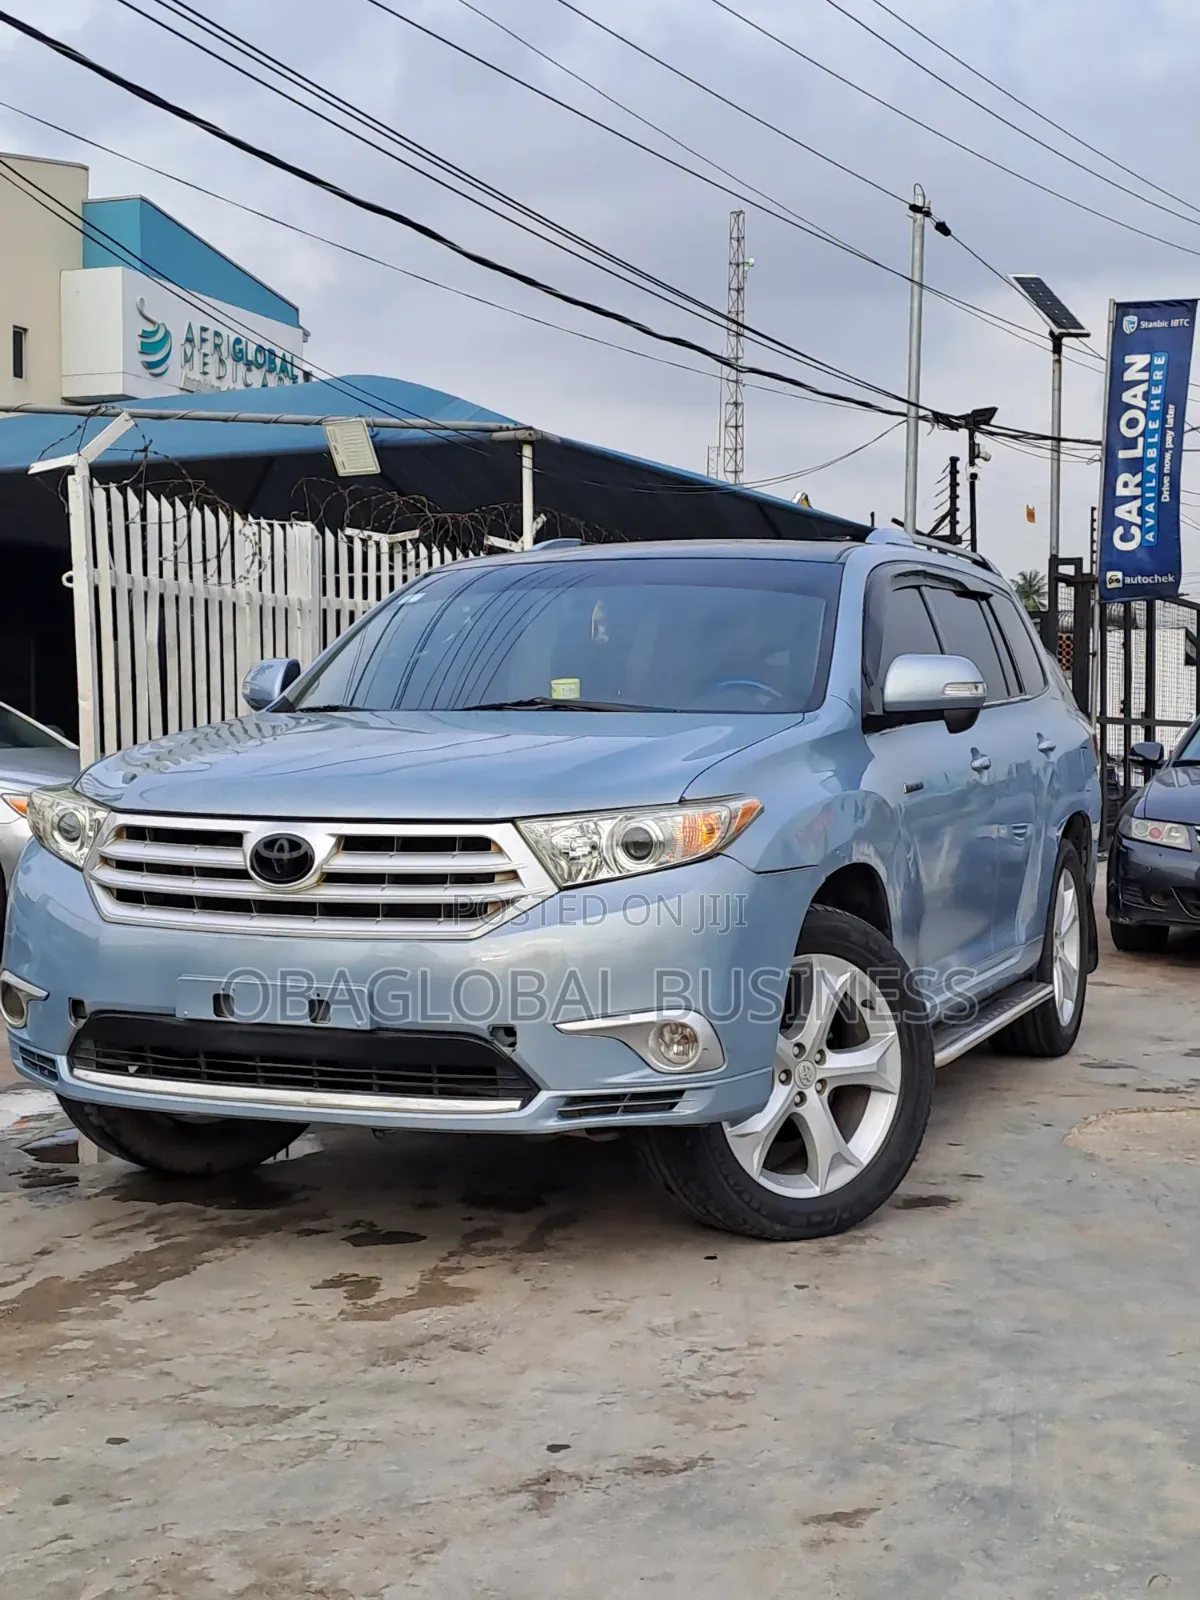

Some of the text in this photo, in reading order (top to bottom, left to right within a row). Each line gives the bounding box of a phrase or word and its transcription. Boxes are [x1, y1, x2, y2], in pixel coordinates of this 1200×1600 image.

[182, 321, 299, 381] AFRIGLOBAL
[1140, 319, 1190, 329] Stanbic IBTC
[180, 343, 298, 388] MEDICAR
[1113, 354, 1151, 551] CAR LOAN
[1144, 355, 1166, 543] AVAILABLE HERE
[1161, 404, 1175, 502] Drive now, pay later
[1124, 574, 1175, 584] autochek
